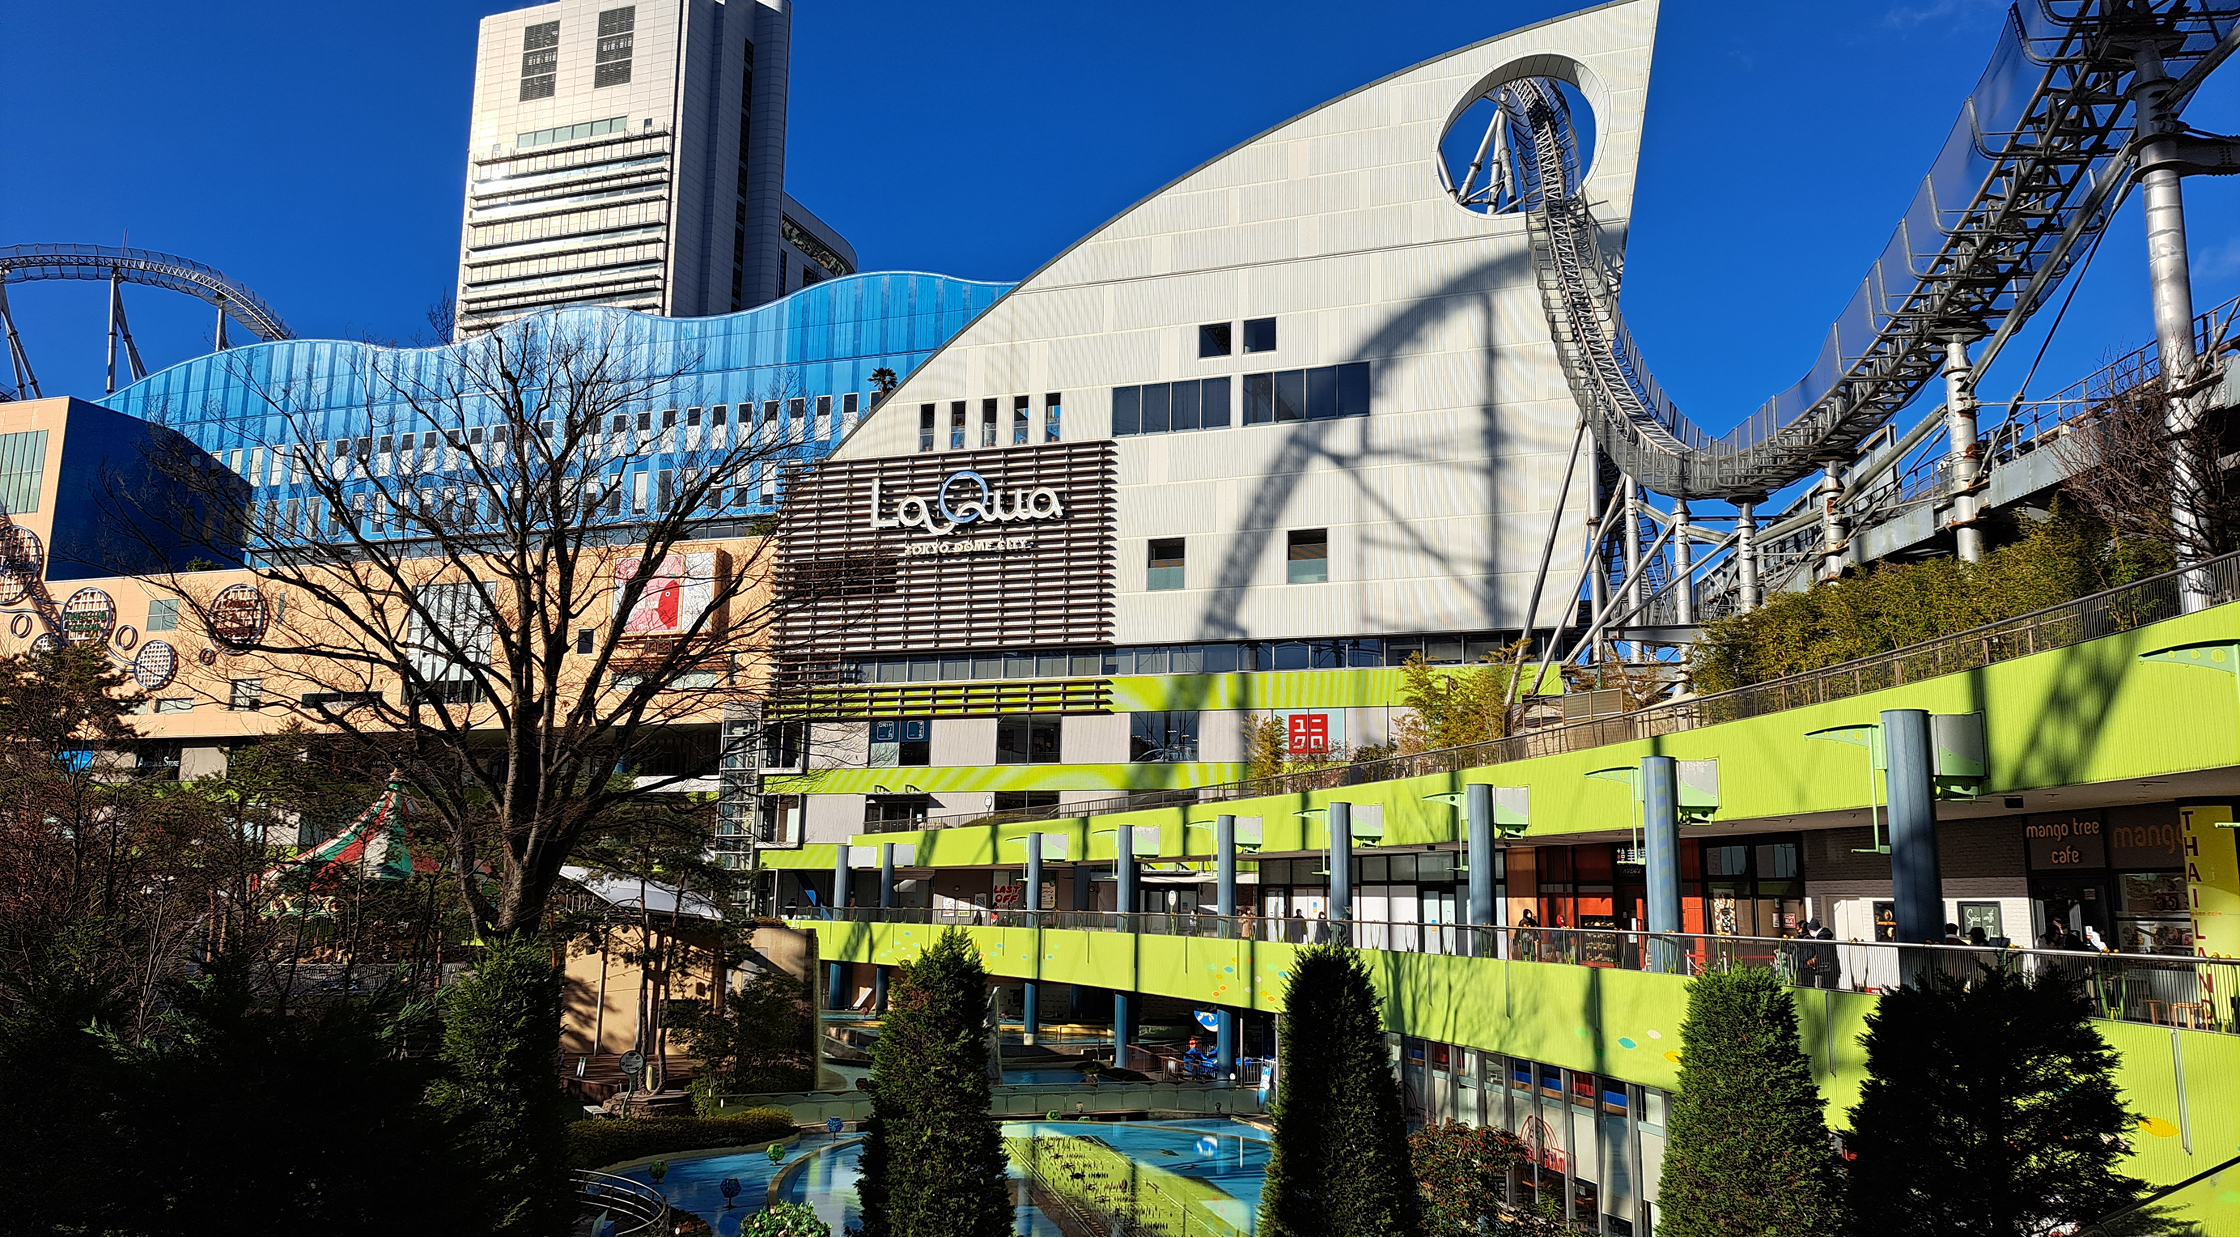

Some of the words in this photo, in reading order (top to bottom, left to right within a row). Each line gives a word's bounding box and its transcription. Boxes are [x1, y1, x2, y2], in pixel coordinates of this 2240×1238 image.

[870, 470, 1063, 536] LaQua
[904, 542, 949, 556] TOKYO
[953, 540, 993, 552] DOME
[996, 538, 1027, 550] CITY
[2026, 823, 2069, 842] mango
[2072, 817, 2100, 836] tree
[2051, 845, 2079, 864] cafe
[993, 885, 1021, 894] LAST
[995, 894, 1019, 903] OFF
